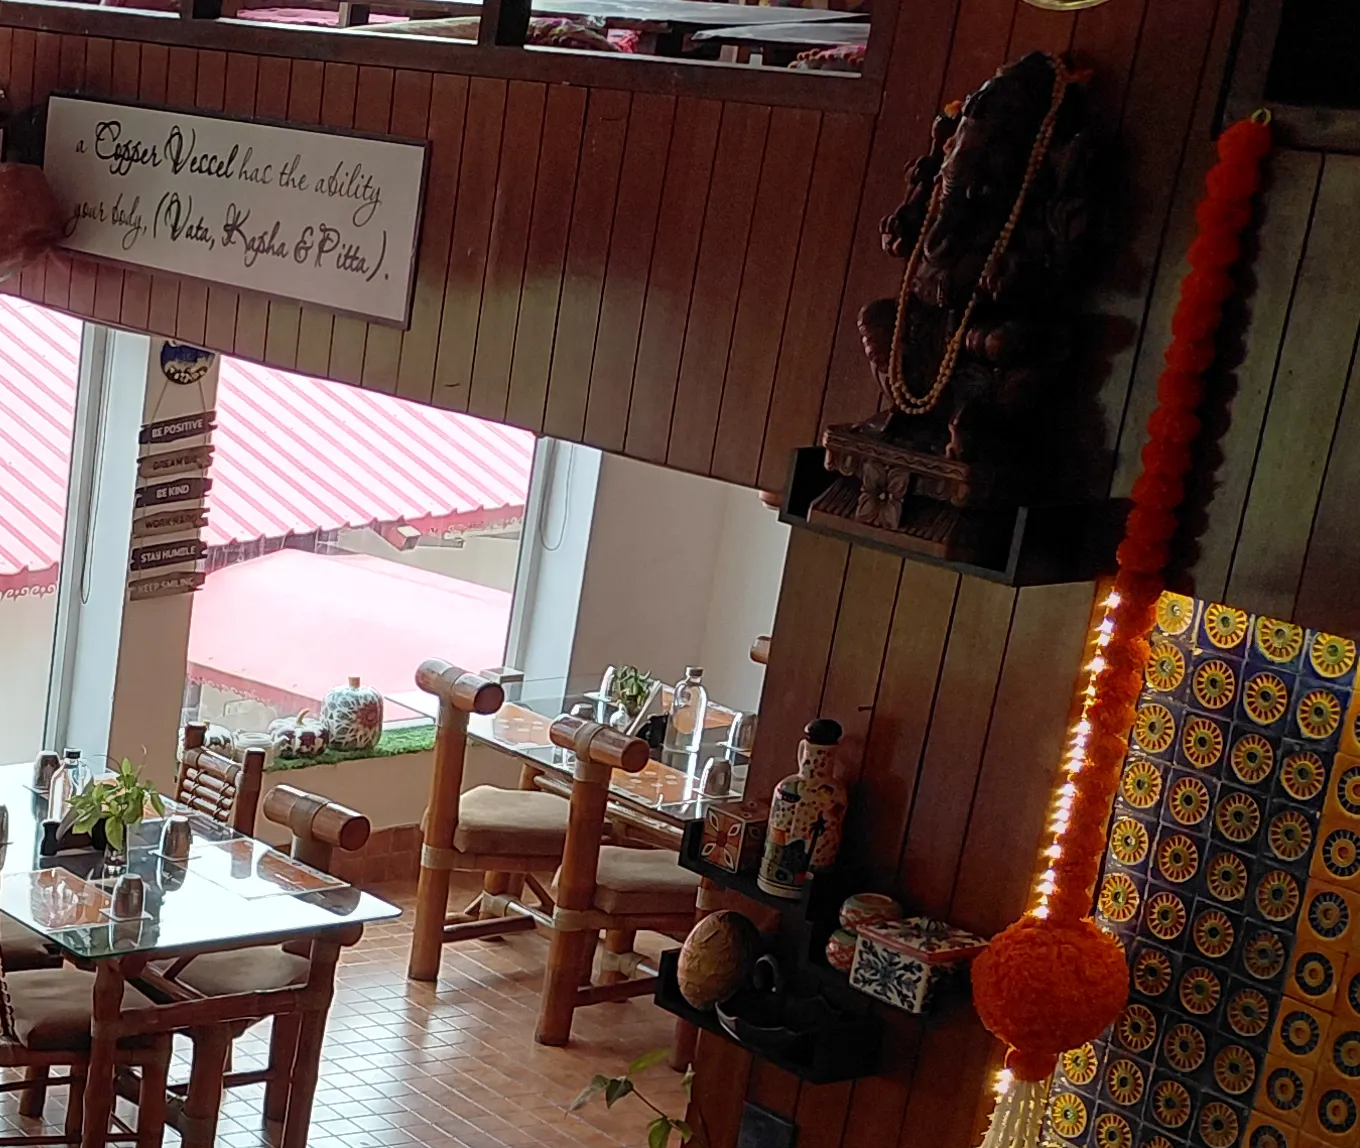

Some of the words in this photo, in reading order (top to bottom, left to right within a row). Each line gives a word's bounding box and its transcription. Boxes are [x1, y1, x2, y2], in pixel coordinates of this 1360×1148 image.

[75, 139, 87, 154] a
[95, 120, 162, 176] Copper
[164, 125, 237, 179] Vessel
[238, 146, 275, 184] has
[279, 154, 309, 191] the
[314, 160, 382, 227] ability
[62, 201, 108, 239] your
[111, 192, 148, 251] body,
[152, 191, 216, 251] (Vata,
[221, 202, 289, 268] Kapha
[293, 226, 314, 264] &
[151, 427, 163, 438] BE
[163, 419, 203, 436] POSITIVE
[156, 489, 167, 499] BE
[168, 484, 190, 497] KIND
[140, 550, 161, 563] STAY
[162, 545, 196, 560] HUMBLE
